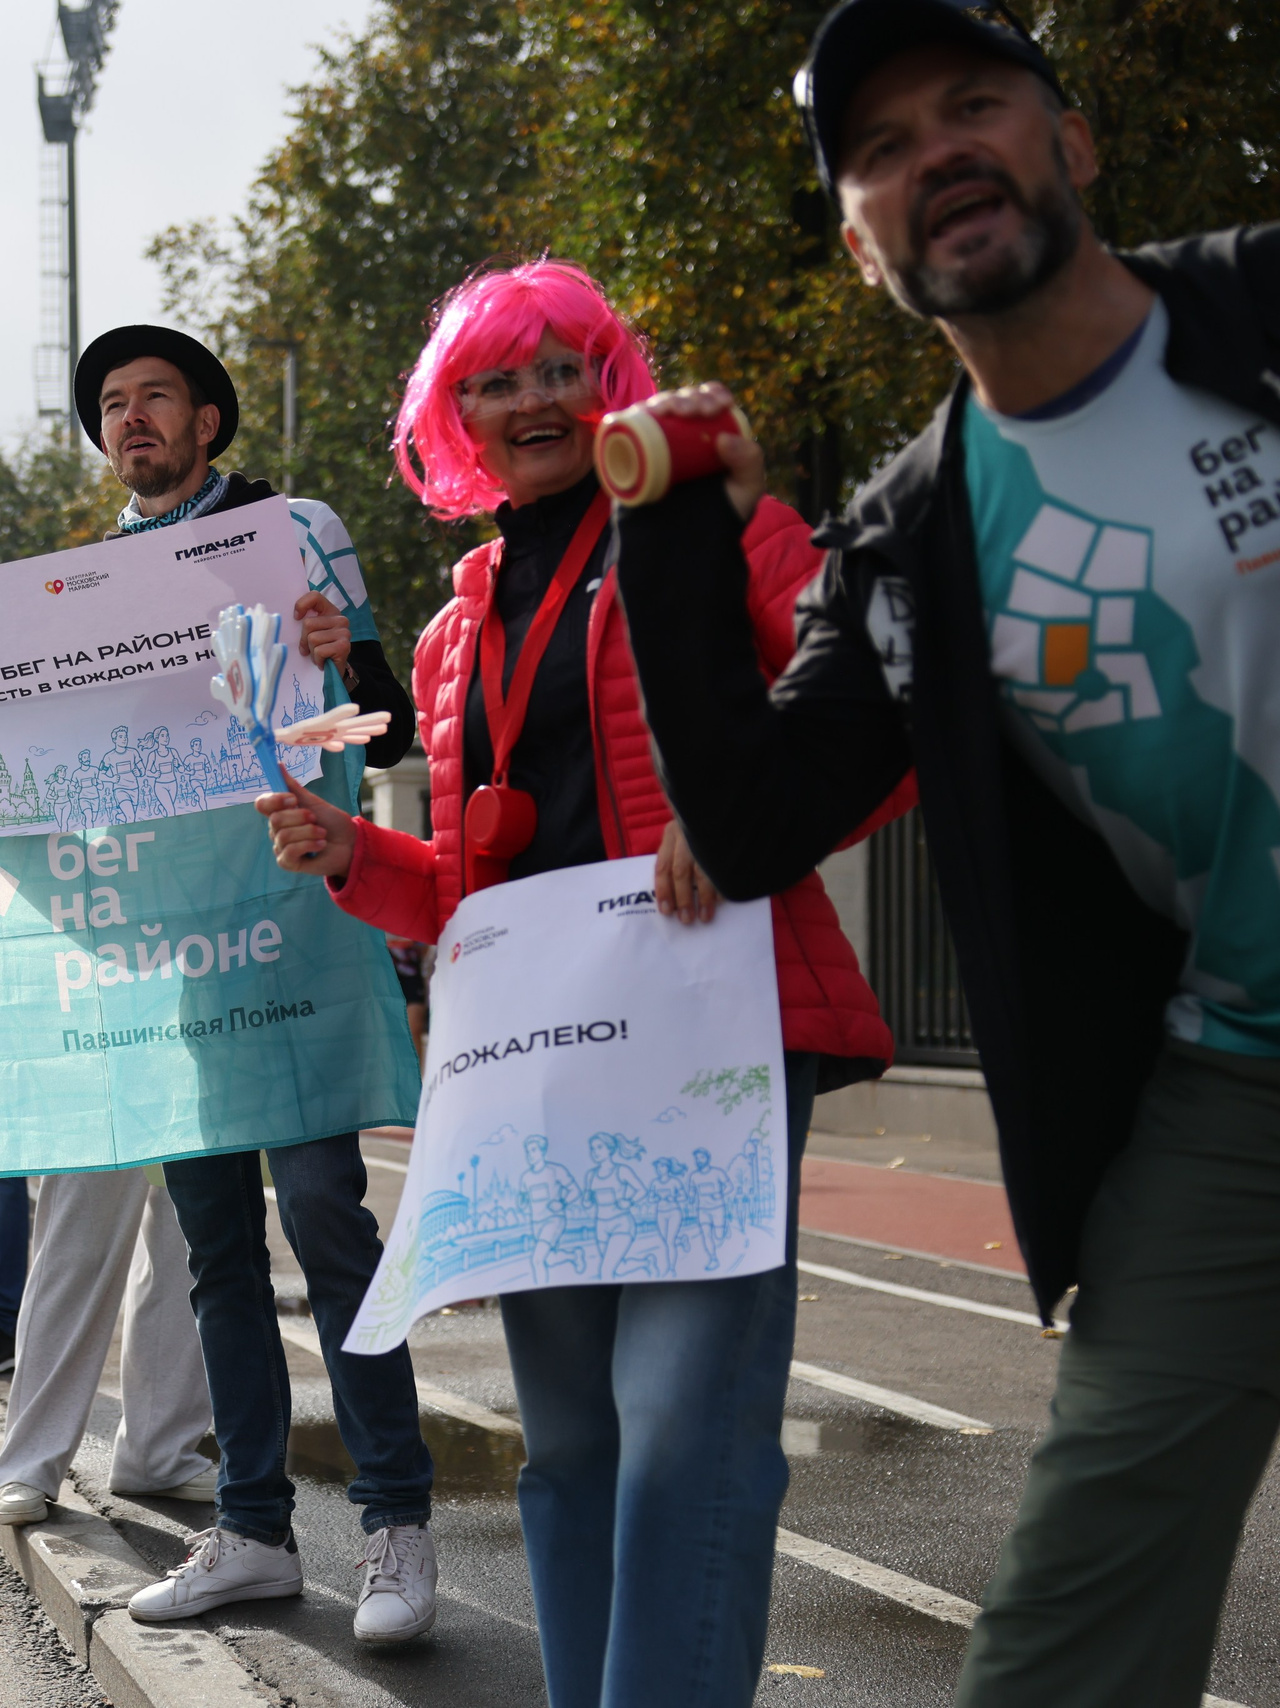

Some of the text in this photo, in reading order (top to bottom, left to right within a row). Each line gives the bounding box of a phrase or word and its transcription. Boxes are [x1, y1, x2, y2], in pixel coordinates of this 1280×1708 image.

[1190, 421, 1267, 477] бег
[1204, 465, 1263, 508] на
[65, 570, 97, 582] СБЕРПРАЙМ
[66, 573, 110, 588] МОСКОВСКИЙ
[68, 582, 100, 593] МАРАФОН
[0, 623, 212, 681] БЕГ НА РАЙОНЕ
[37, 681, 52, 694] в
[57, 660, 155, 690] каждом
[160, 653, 189, 669] из
[47, 830, 156, 881] бег
[50, 885, 127, 933] на
[597, 890, 656, 913] ГИГА
[54, 918, 284, 1013] районе
[62, 998, 317, 1053] Павшинская Пойма
[439, 1018, 629, 1085] ПОЖАЛЕЮ!
